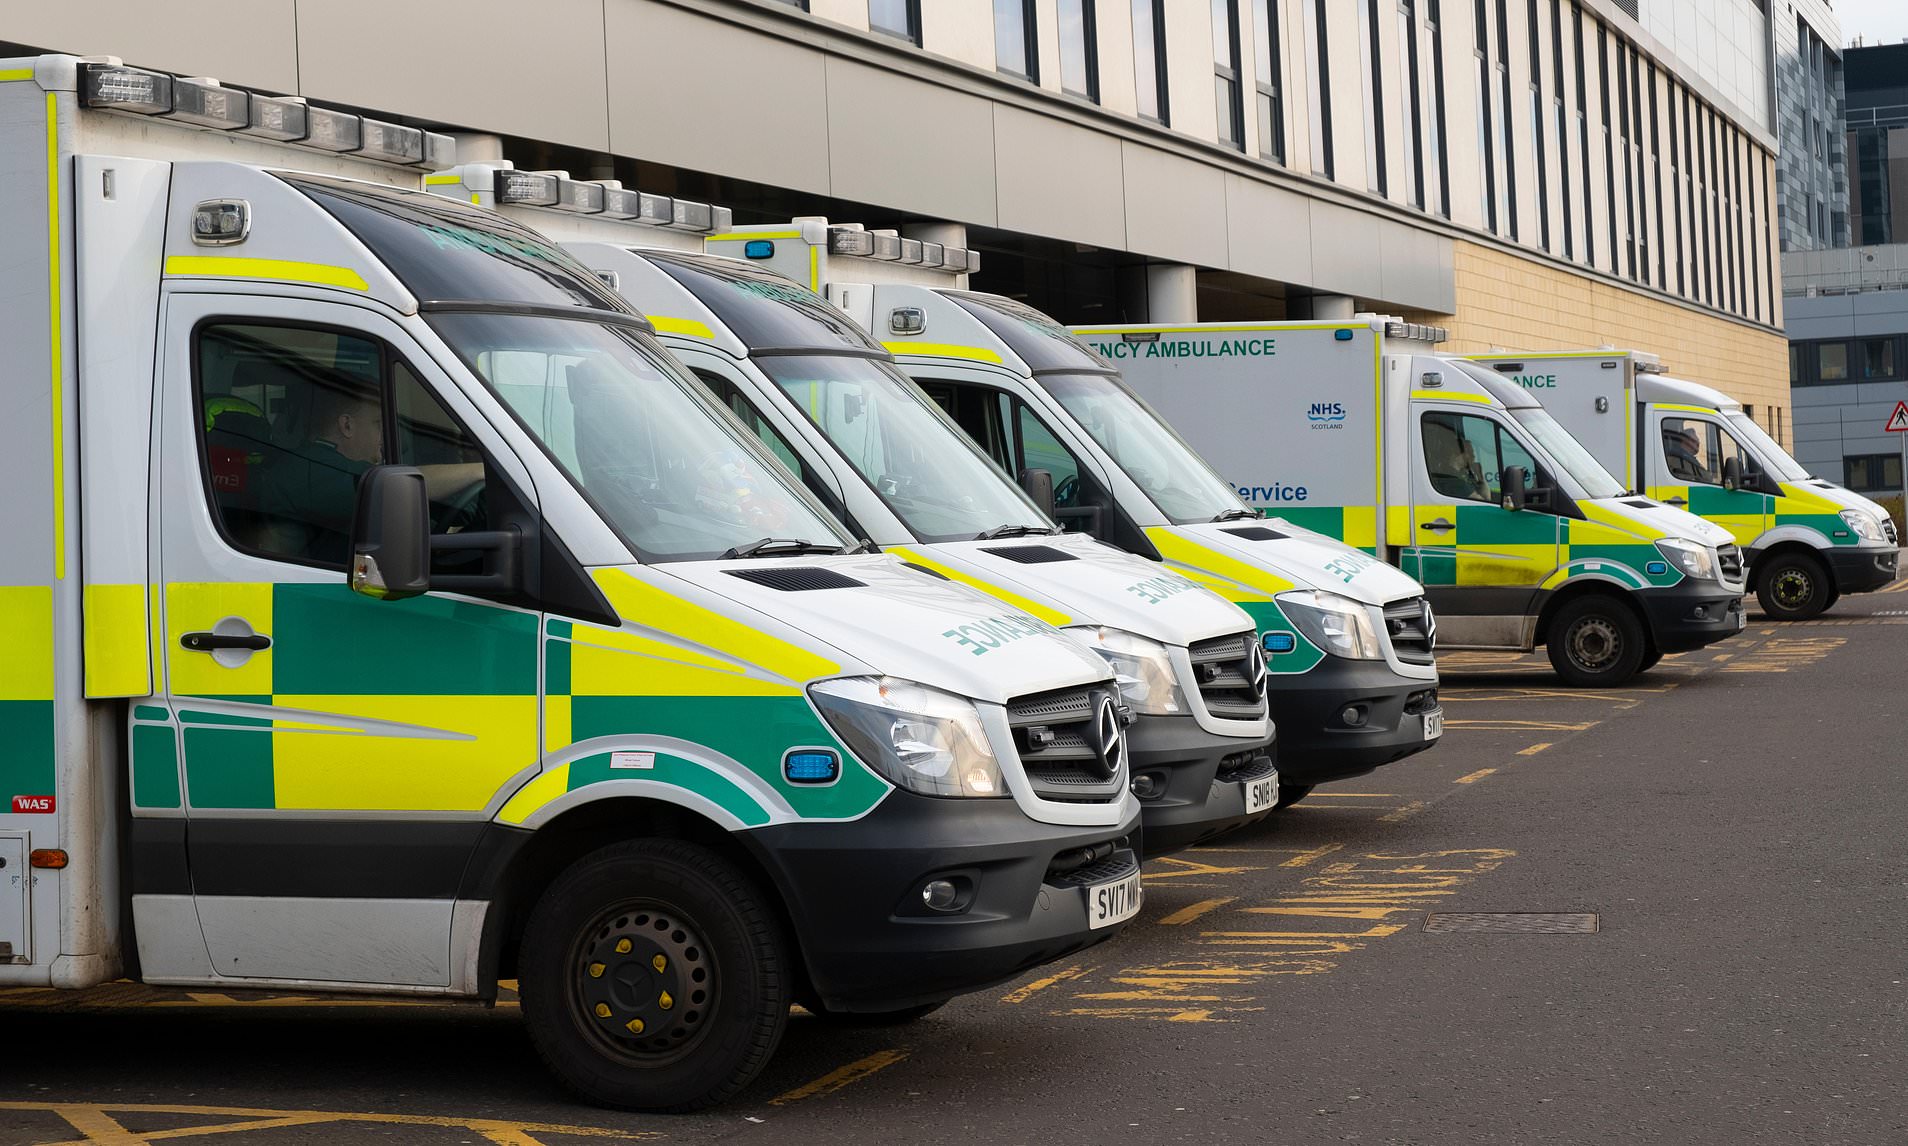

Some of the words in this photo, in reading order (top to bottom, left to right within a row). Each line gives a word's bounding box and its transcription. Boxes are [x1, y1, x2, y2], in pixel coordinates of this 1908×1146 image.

[1146, 340, 1275, 358] AMBULANCE
[1311, 403, 1342, 415] NHS
[1311, 423, 1343, 431] SCOTLAND
[1229, 482, 1308, 501] ervice
[18, 798, 49, 810] WAS
[1098, 884, 1125, 919] SV17
